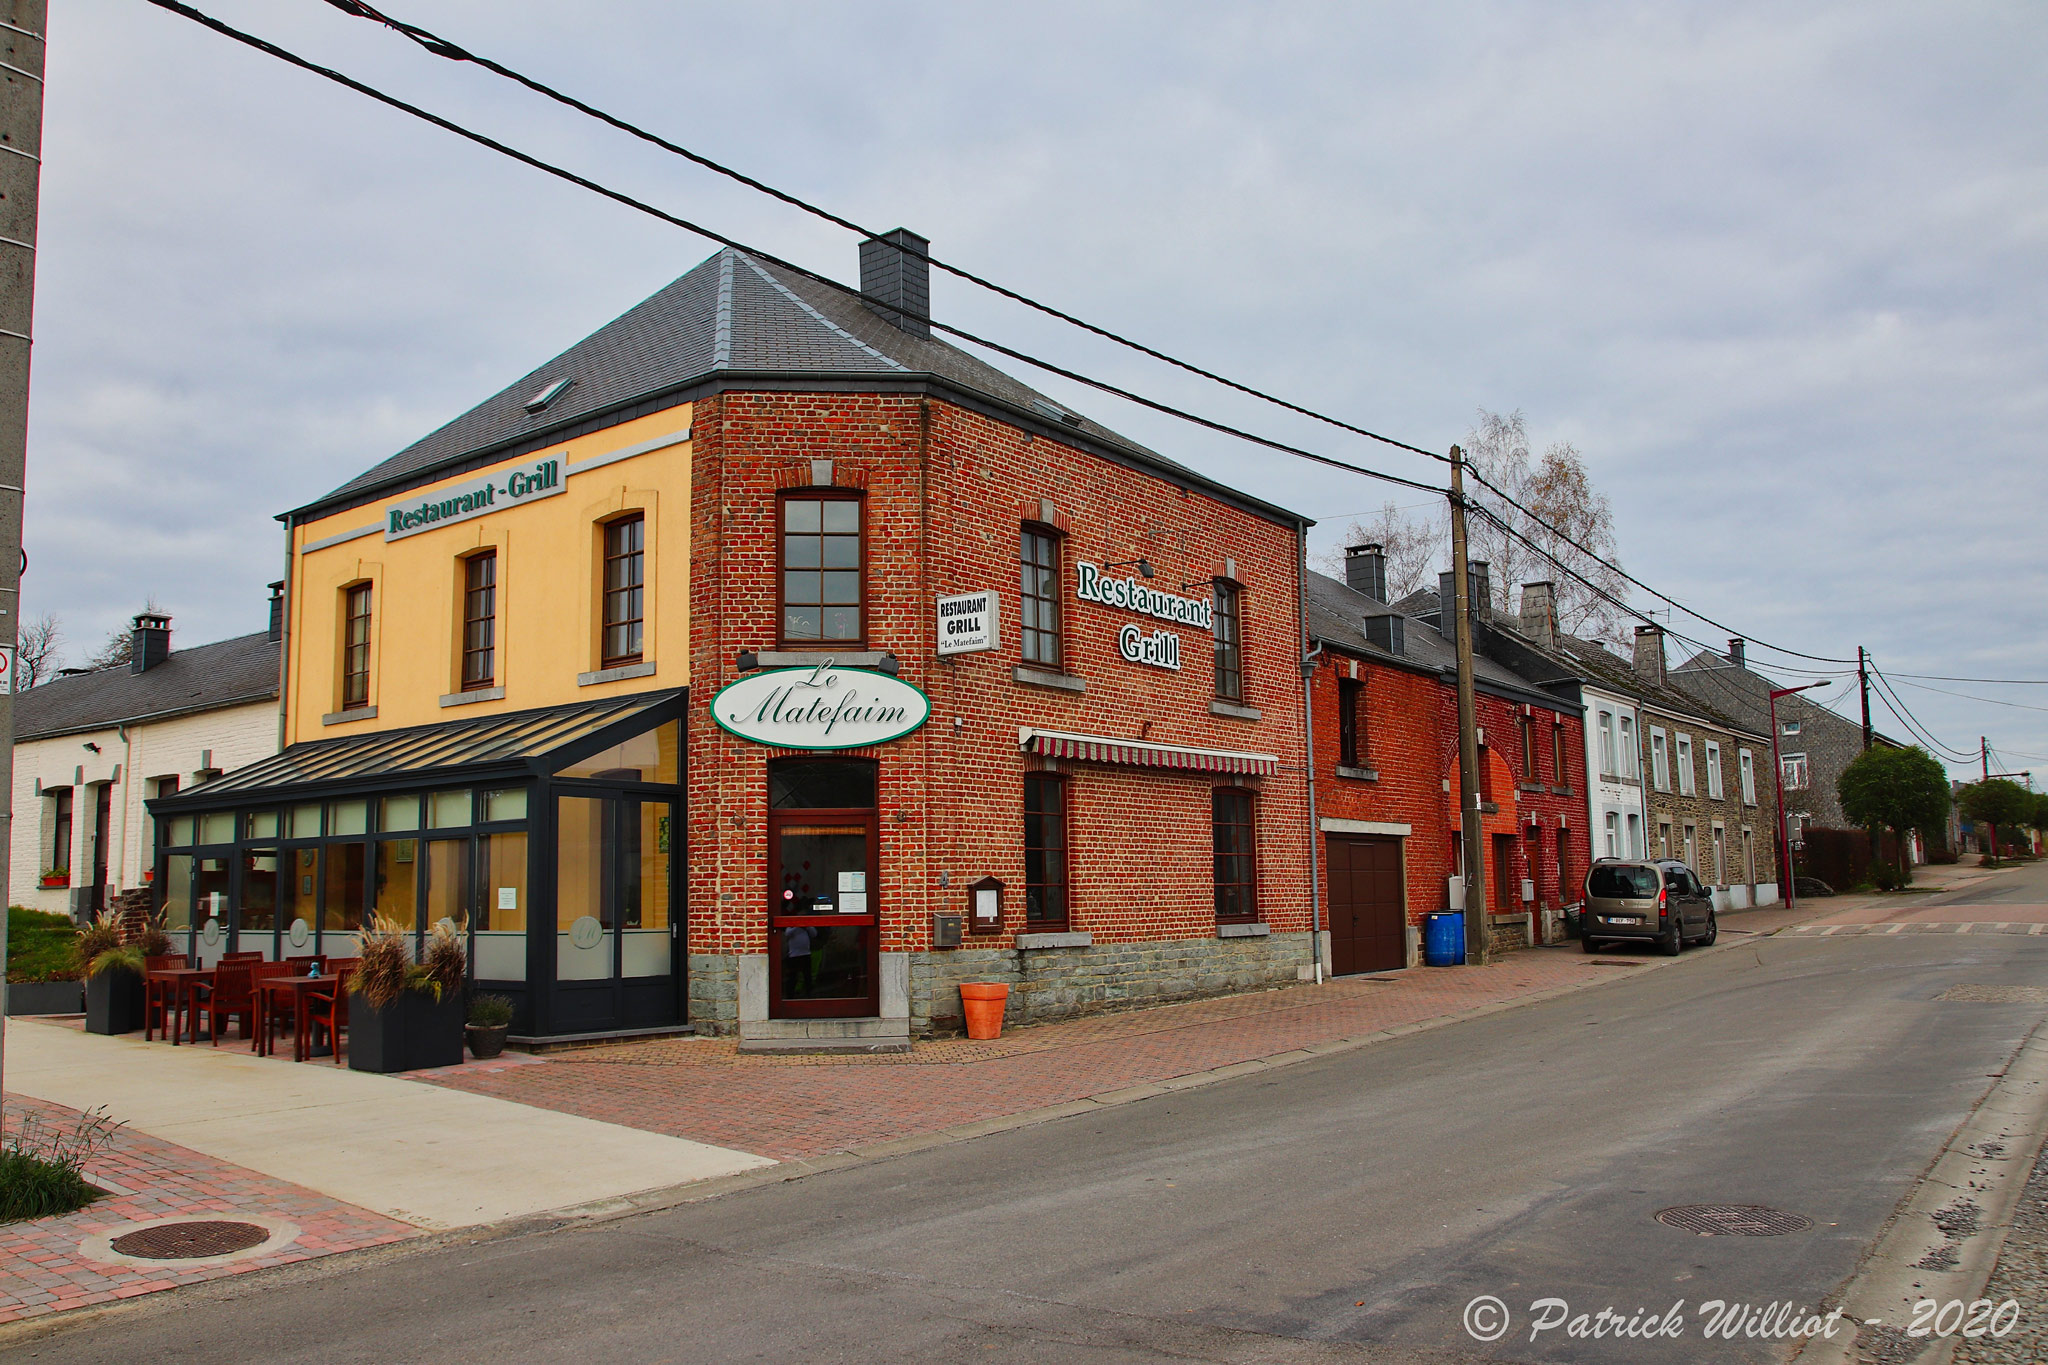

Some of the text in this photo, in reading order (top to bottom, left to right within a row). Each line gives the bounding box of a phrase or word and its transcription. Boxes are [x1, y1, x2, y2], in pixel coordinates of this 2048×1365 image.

[389, 483, 495, 533] Restaurant
[508, 459, 558, 498] Grill
[940, 597, 987, 618] RESTAURANT
[1078, 562, 1213, 628] Restaurant
[946, 616, 981, 636] GRILL
[1120, 624, 1180, 669] Grill
[795, 656, 838, 689] Le
[729, 686, 908, 736] Matefaim
[939, 869, 950, 889] 4
